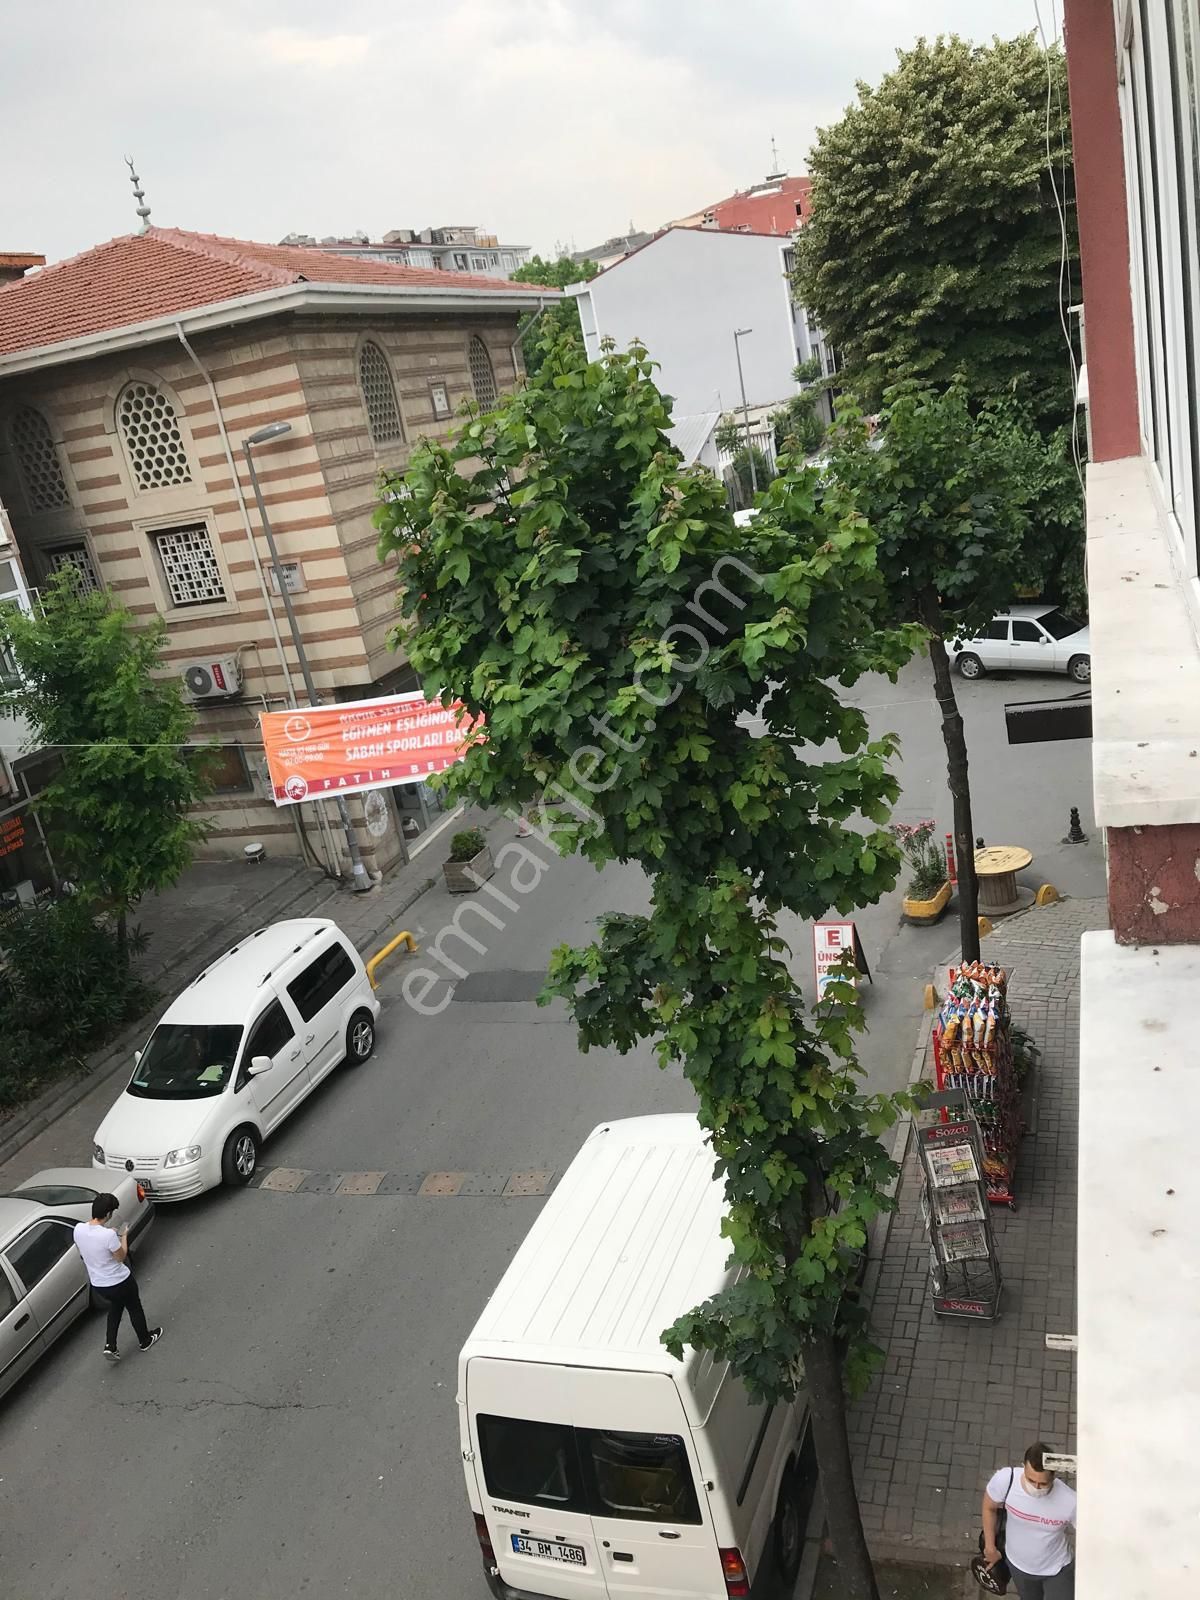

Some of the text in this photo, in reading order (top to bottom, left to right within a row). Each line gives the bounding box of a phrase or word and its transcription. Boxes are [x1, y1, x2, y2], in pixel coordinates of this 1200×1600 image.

[396, 709, 456, 733] EŞLİĞİNDE
[345, 744, 384, 762] SABAH
[386, 732, 443, 755] SPORLARI
[323, 769, 391, 789] FATİH
[827, 930, 841, 946] E
[492, 1505, 530, 1518] TRANSIT
[519, 1539, 532, 1552] 34
[537, 1542, 552, 1556] BM
[558, 1546, 582, 1562] 1486
